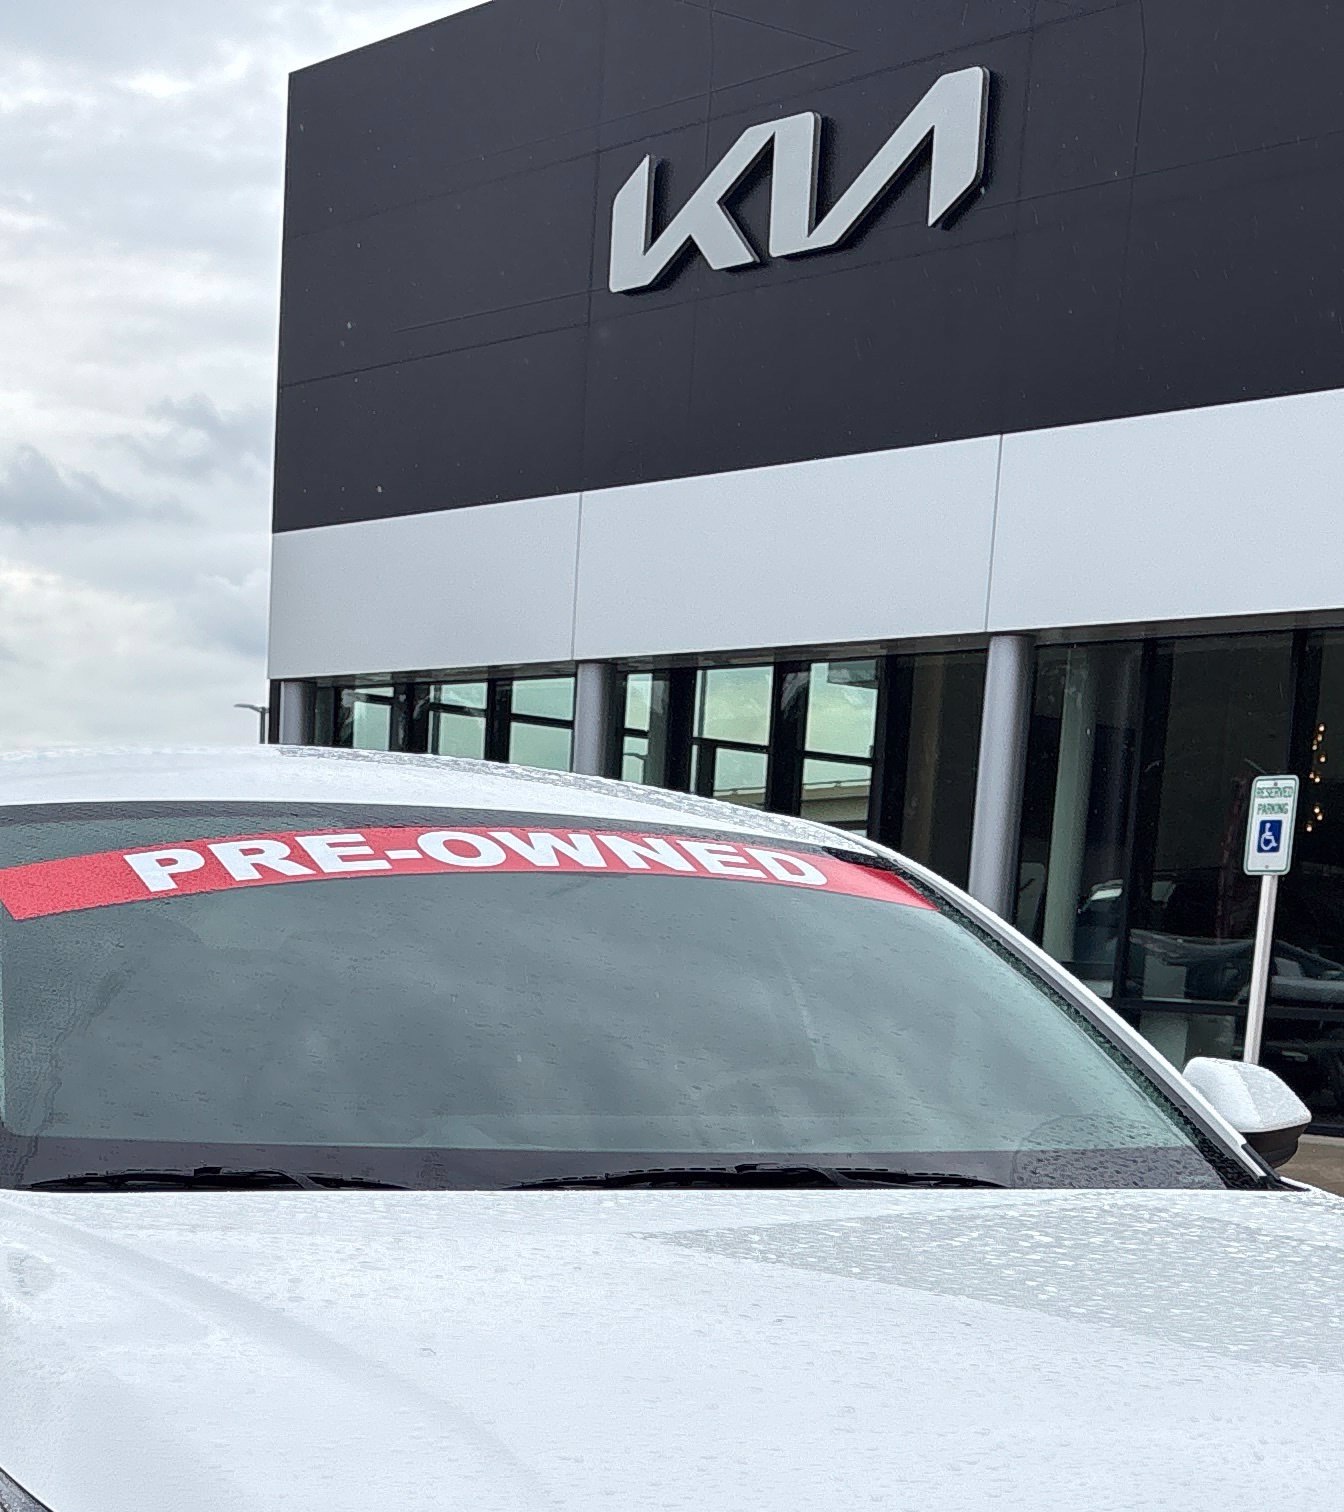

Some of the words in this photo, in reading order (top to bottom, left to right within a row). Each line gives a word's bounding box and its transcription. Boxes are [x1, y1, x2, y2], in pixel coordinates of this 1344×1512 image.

[608, 65, 990, 293] KIA
[1256, 786, 1294, 799] RESERVED
[1257, 803, 1289, 815] PARKING
[122, 829, 829, 893] PRE-OWNED
